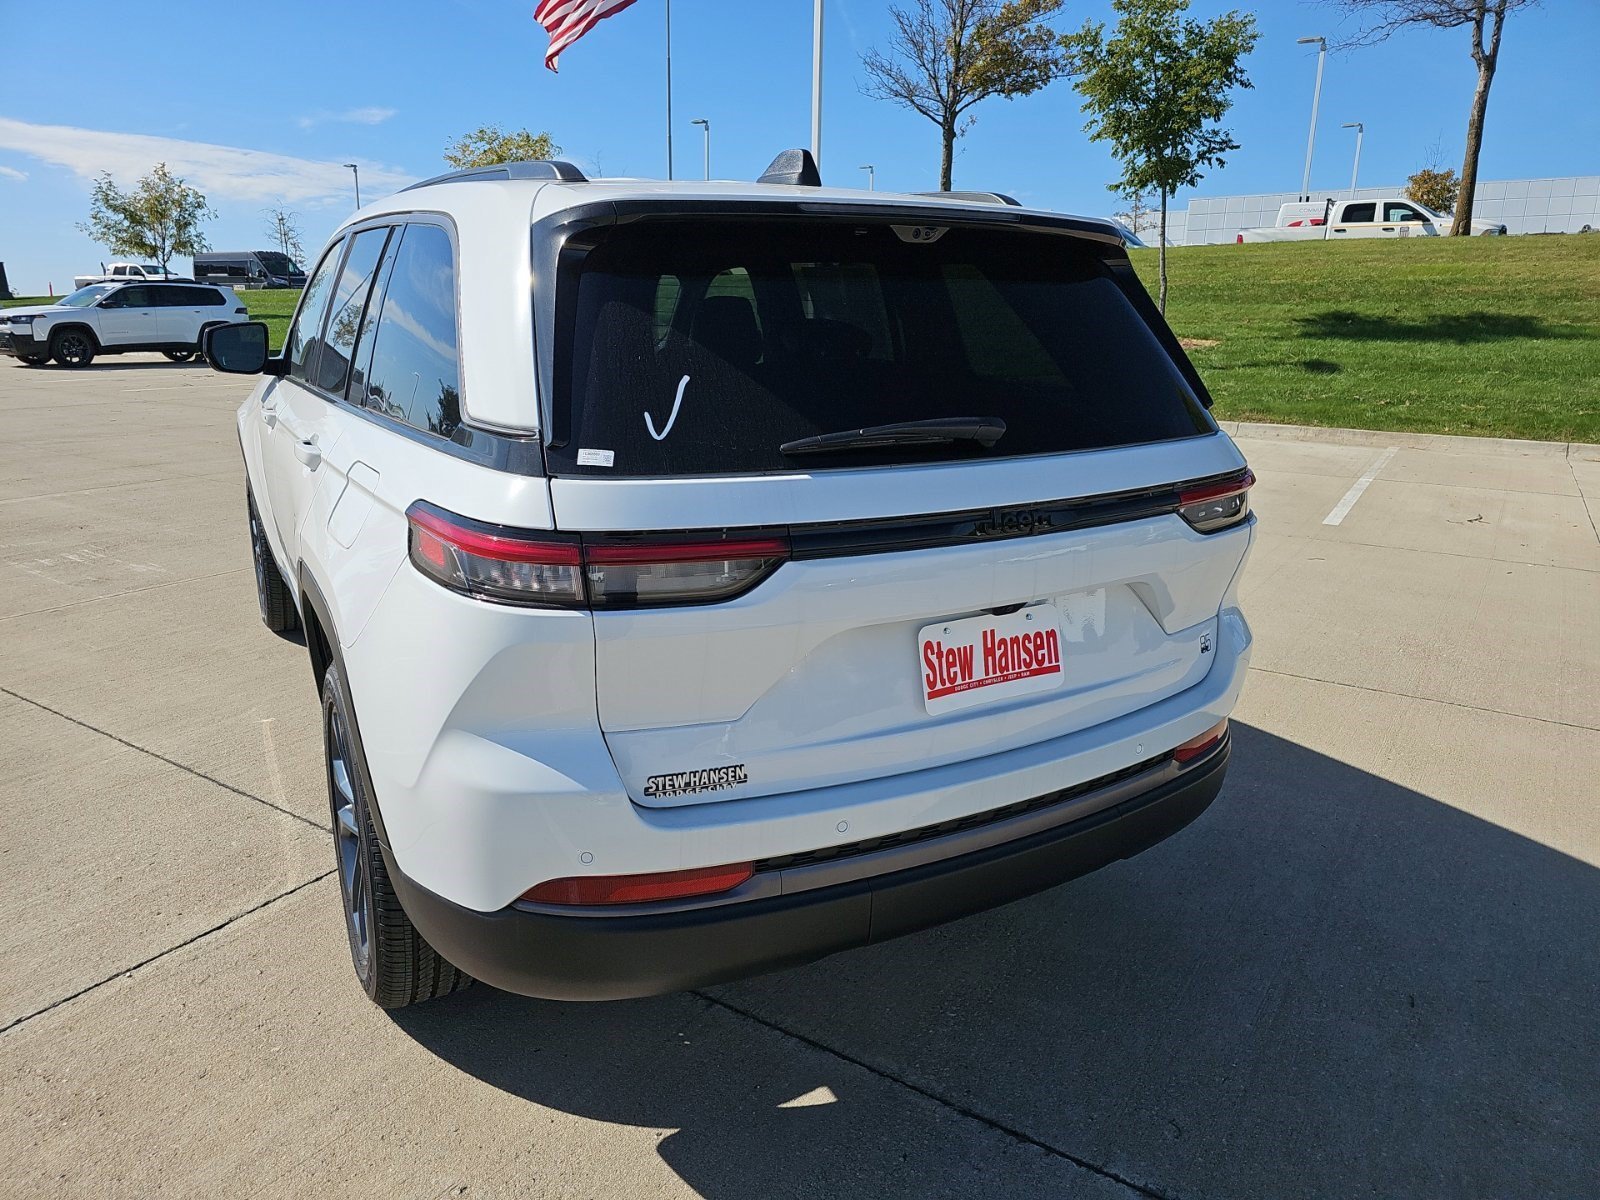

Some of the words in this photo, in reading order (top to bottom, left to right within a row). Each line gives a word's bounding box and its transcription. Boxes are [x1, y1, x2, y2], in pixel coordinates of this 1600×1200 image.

[976, 507, 1051, 535] Jeep
[923, 640, 974, 690] Stew
[982, 628, 1060, 677] Hansen
[982, 676, 1004, 685] CHRYSLER
[648, 773, 688, 792] STEW
[690, 764, 745, 786] HANSEN
